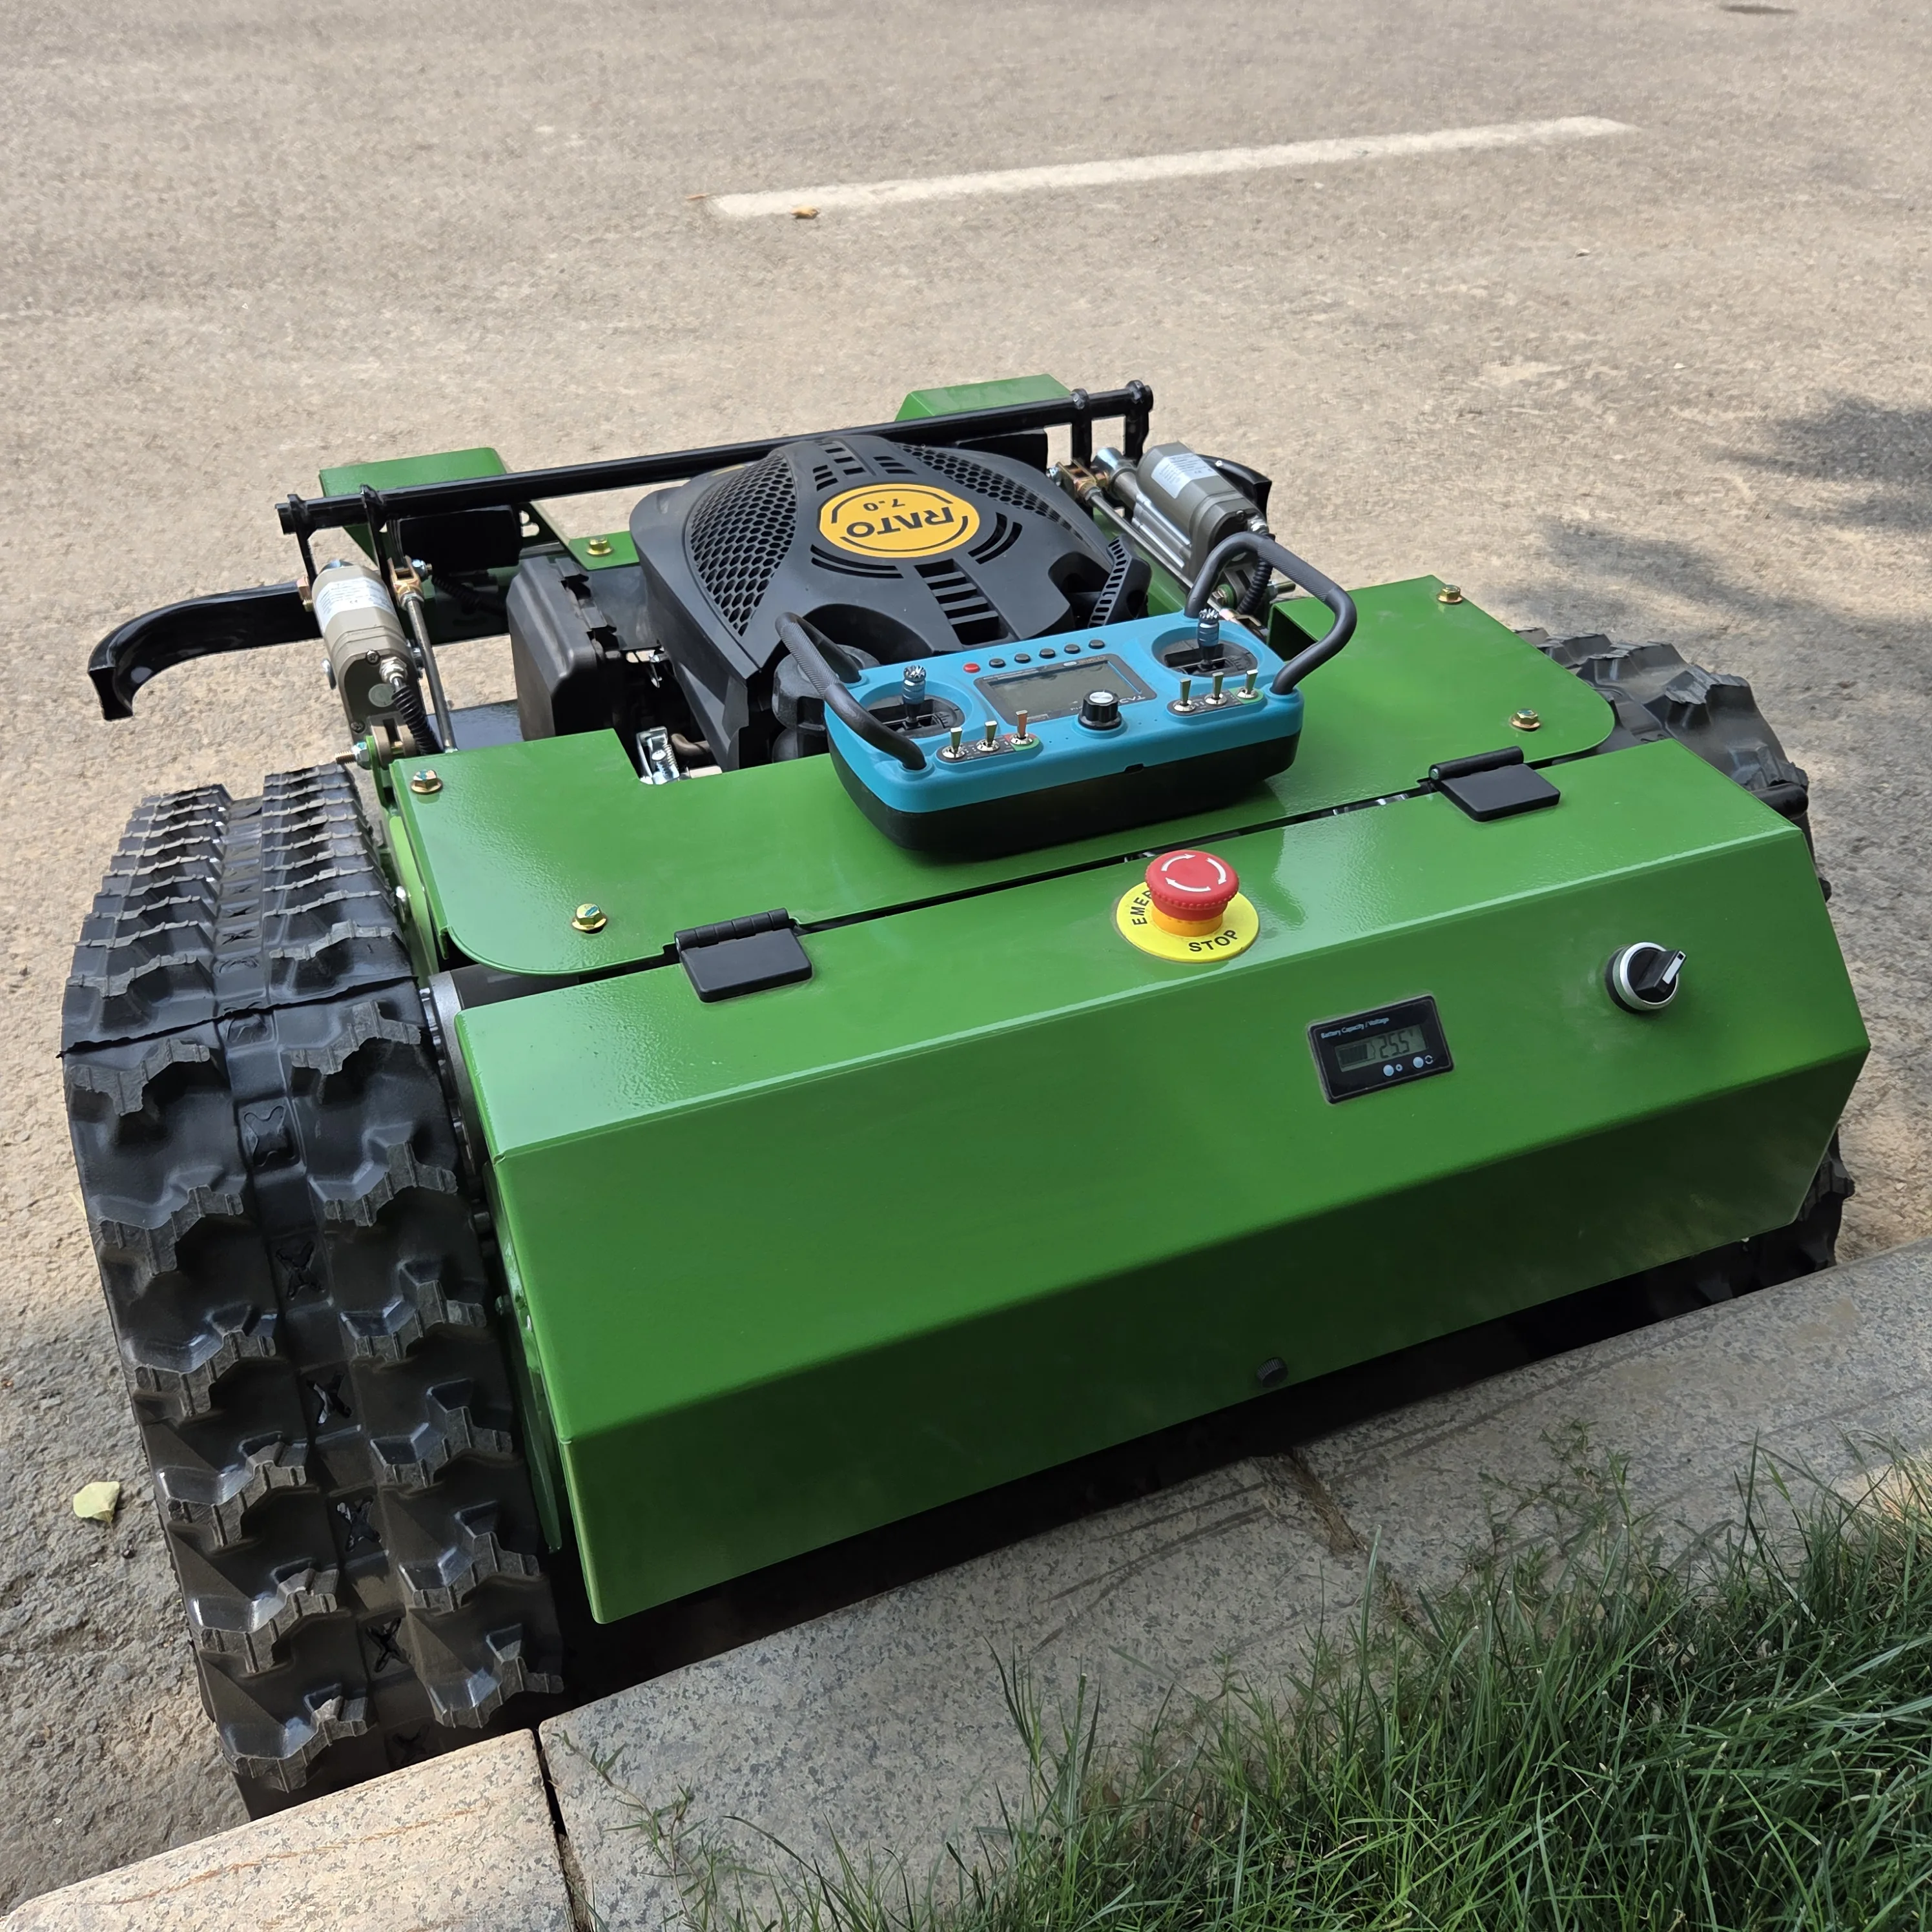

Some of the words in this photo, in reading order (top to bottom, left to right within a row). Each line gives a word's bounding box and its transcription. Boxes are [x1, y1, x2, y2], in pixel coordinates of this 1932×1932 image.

[846, 506, 954, 538] RATO
[1188, 930, 1238, 952] STOP
[1321, 1030, 1341, 1039] Battery
[1341, 1023, 1364, 1033] Capacity
[1368, 1017, 1390, 1025] Voltage
